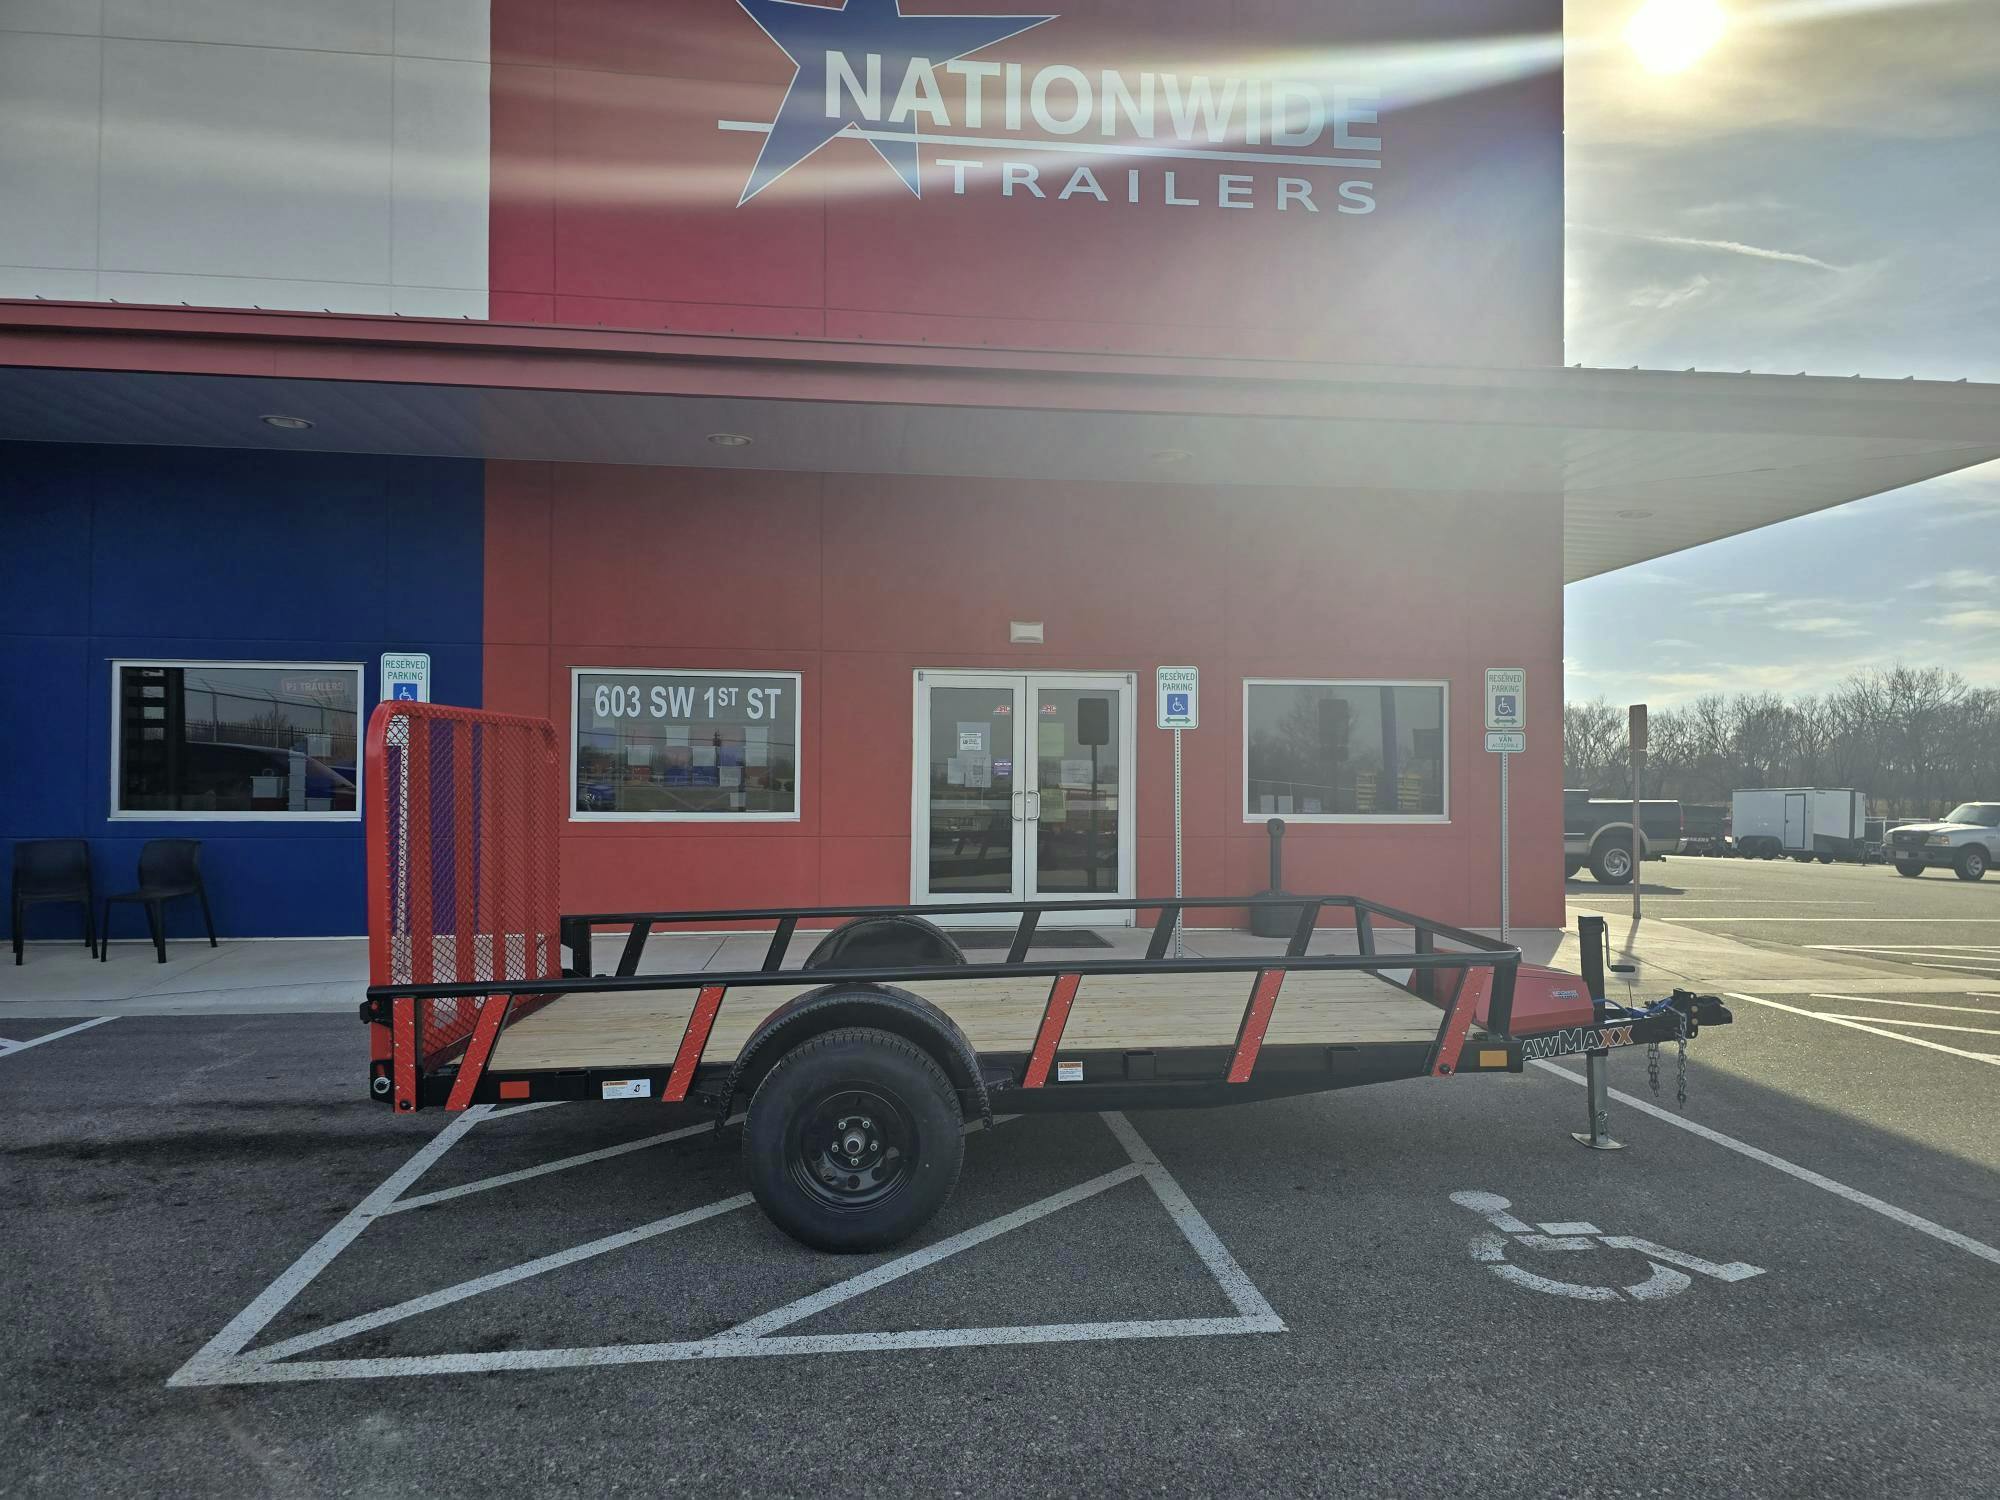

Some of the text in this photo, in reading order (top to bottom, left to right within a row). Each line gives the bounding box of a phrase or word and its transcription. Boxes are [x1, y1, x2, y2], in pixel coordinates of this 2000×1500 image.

[825, 49, 1382, 152] NATIONWIDE
[936, 158, 1377, 215] TRAILERS
[385, 660, 426, 669] RESERVED
[387, 671, 423, 681] PARKING
[1160, 672, 1195, 681] RESERVED
[1488, 674, 1522, 683] RESERVED
[1162, 682, 1193, 691] PARKING
[1491, 684, 1520, 693] PARKING
[594, 685, 641, 718] 603
[649, 686, 695, 719] SW
[746, 687, 782, 720] ST
[1522, 1025, 1634, 1061] AWMAXX
